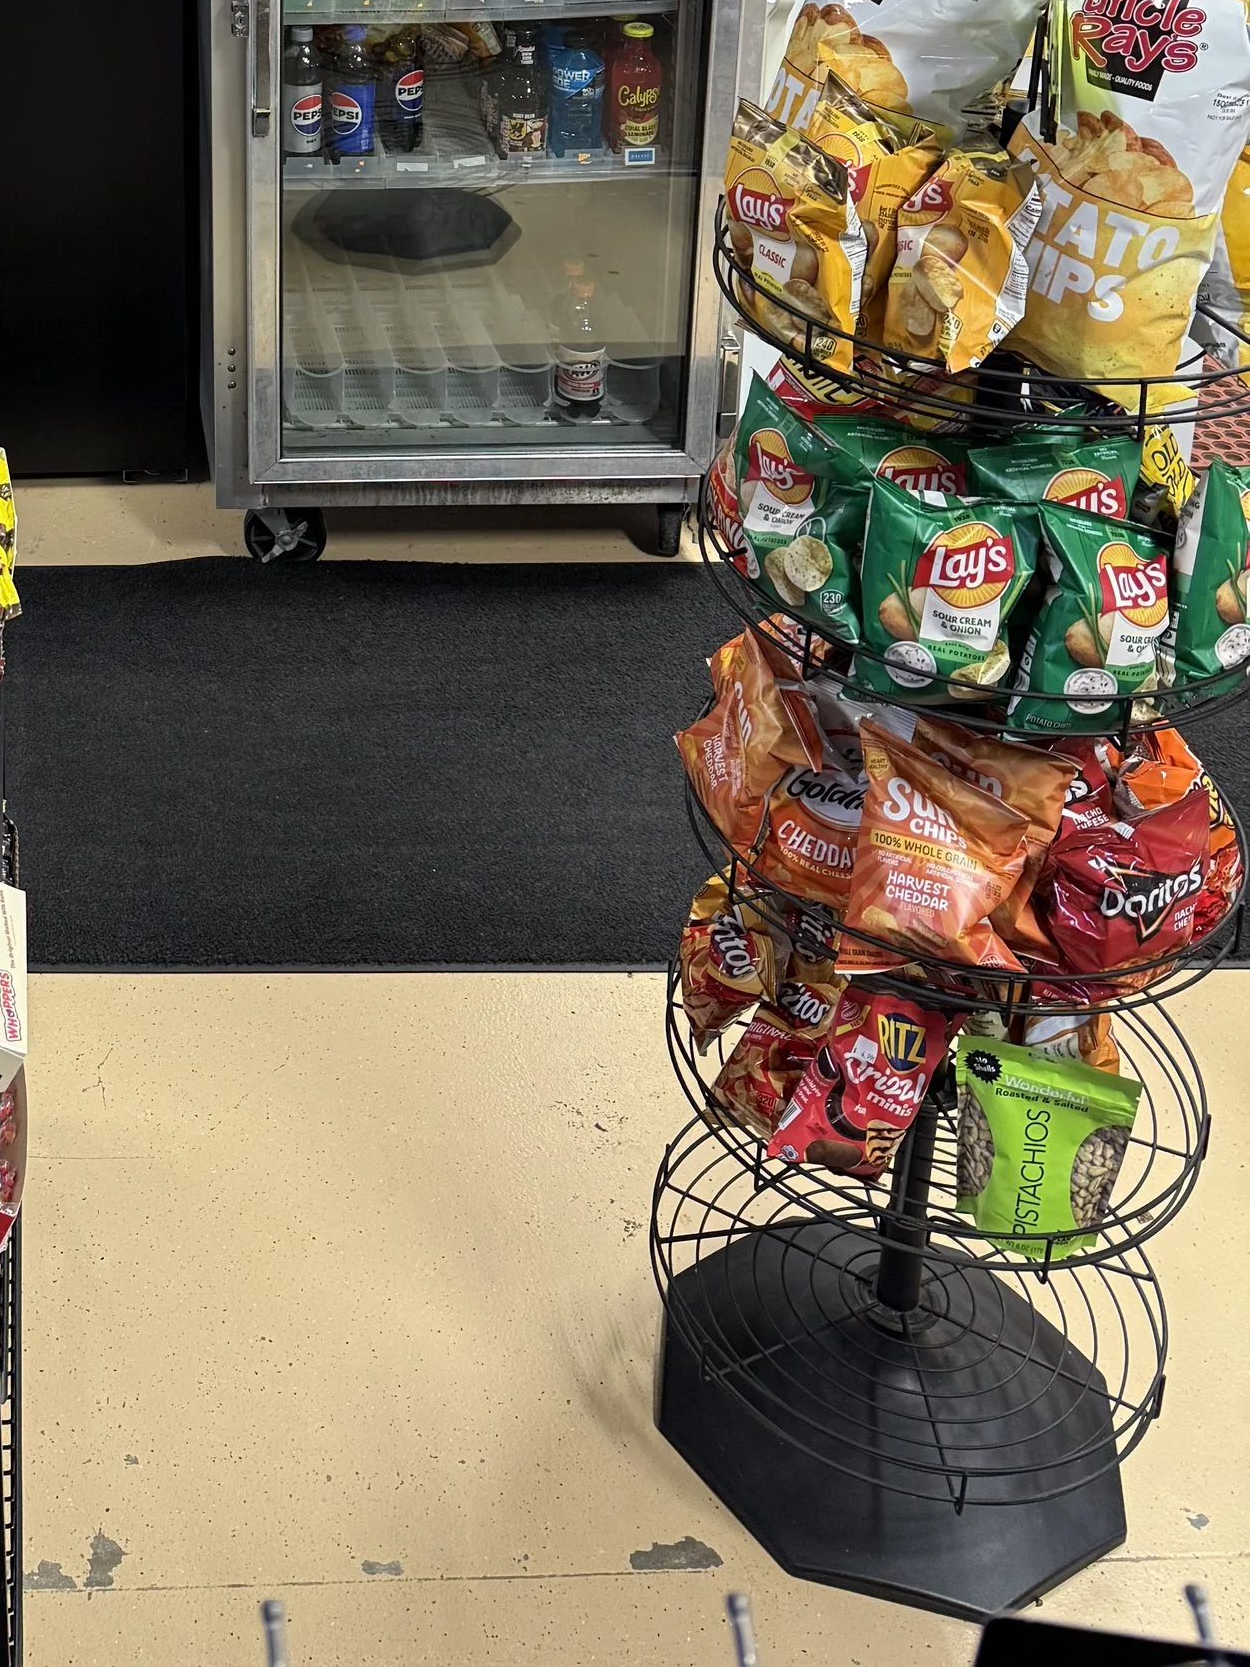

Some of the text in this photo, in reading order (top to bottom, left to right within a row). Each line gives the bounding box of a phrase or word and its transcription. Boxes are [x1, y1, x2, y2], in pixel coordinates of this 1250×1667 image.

[1069, 10, 1200, 73] Ray's
[1115, 75, 1153, 91] QUALITY FOODS
[734, 183, 785, 232] Lay's
[758, 243, 787, 269] CLASSIC
[815, 337, 834, 353] 240
[757, 502, 781, 517] SOUR
[930, 537, 1008, 589] Lay's
[823, 592, 842, 604] 230
[1106, 562, 1167, 609] Lay's
[932, 609, 992, 628] SOUR CREAM
[940, 619, 982, 636] & ONION
[928, 644, 947, 656] REAL
[883, 776, 961, 834] Sun
[909, 815, 969, 850] CHIPS
[873, 832, 902, 849] 100%
[903, 839, 943, 859] WHOLE
[944, 851, 978, 871] GRAIN
[886, 869, 951, 898] HARVEST
[1100, 863, 1202, 917] Doritos
[885, 885, 949, 912] CHEDDAR
[877, 1013, 927, 1065] RITZ
[973, 1063, 997, 1074] Shells
[995, 1087, 1090, 1114] Roasted & Salted
[1003, 1073, 1088, 1106] Wonderful
[866, 1090, 912, 1119] minis
[1012, 1108, 1052, 1235] PISTACHIOS
